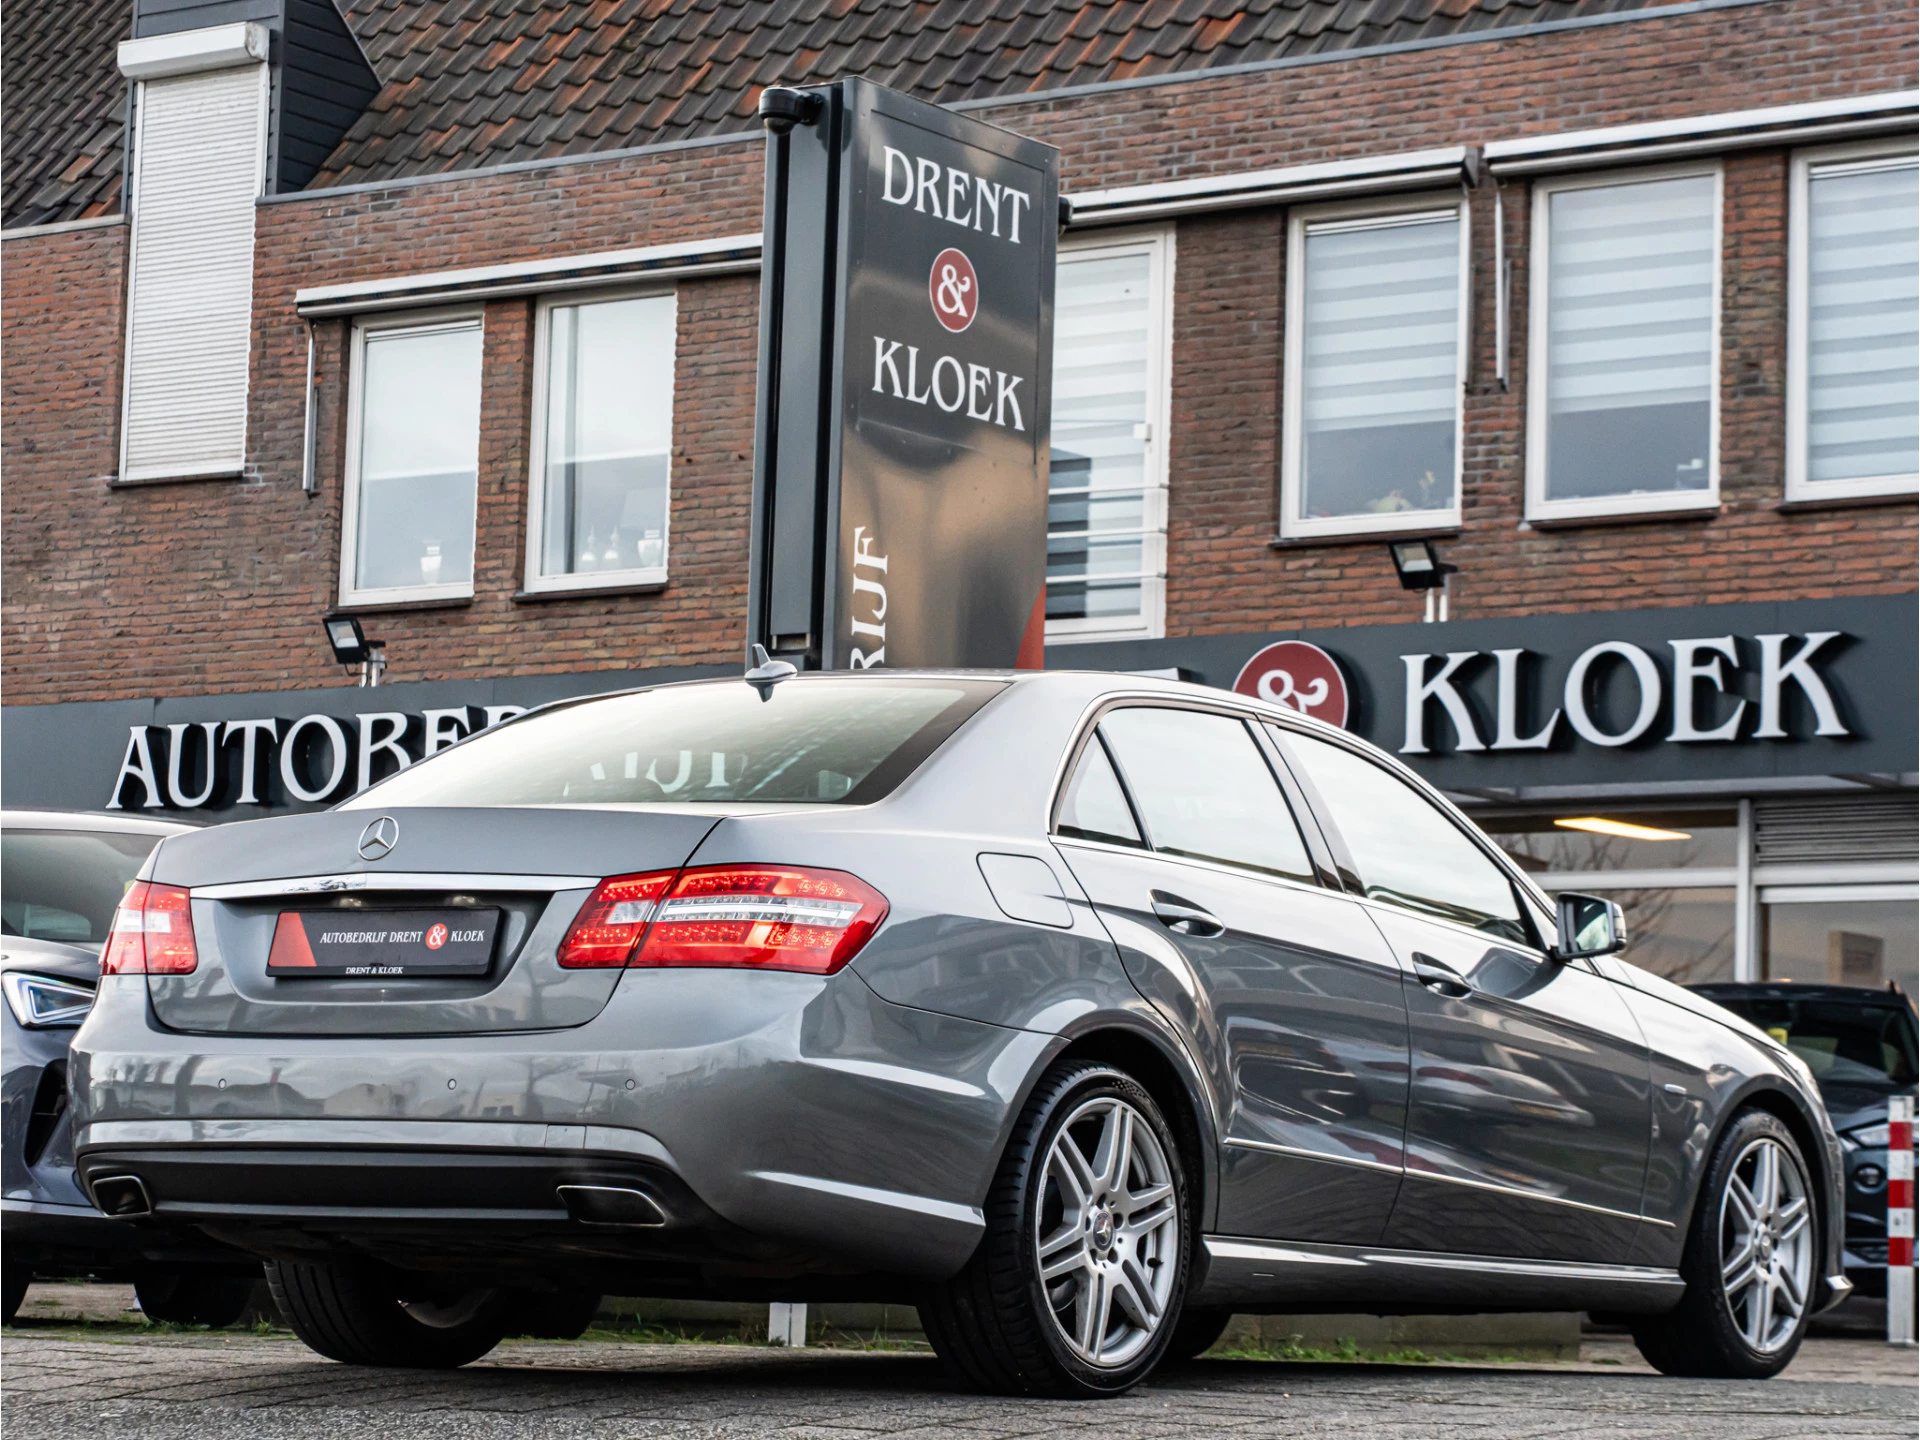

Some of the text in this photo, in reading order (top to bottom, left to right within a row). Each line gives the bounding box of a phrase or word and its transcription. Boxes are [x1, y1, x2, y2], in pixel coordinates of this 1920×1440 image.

[881, 145, 1030, 244] DRENT
[937, 263, 971, 318] &
[871, 335, 1026, 431] KLOEK
[1398, 631, 1850, 754] KLOEK
[319, 925, 485, 946] AUTOBEDRIJF DRENT & KLOEK
[345, 966, 371, 974] DRENT
[378, 966, 404, 974] KLOEK
